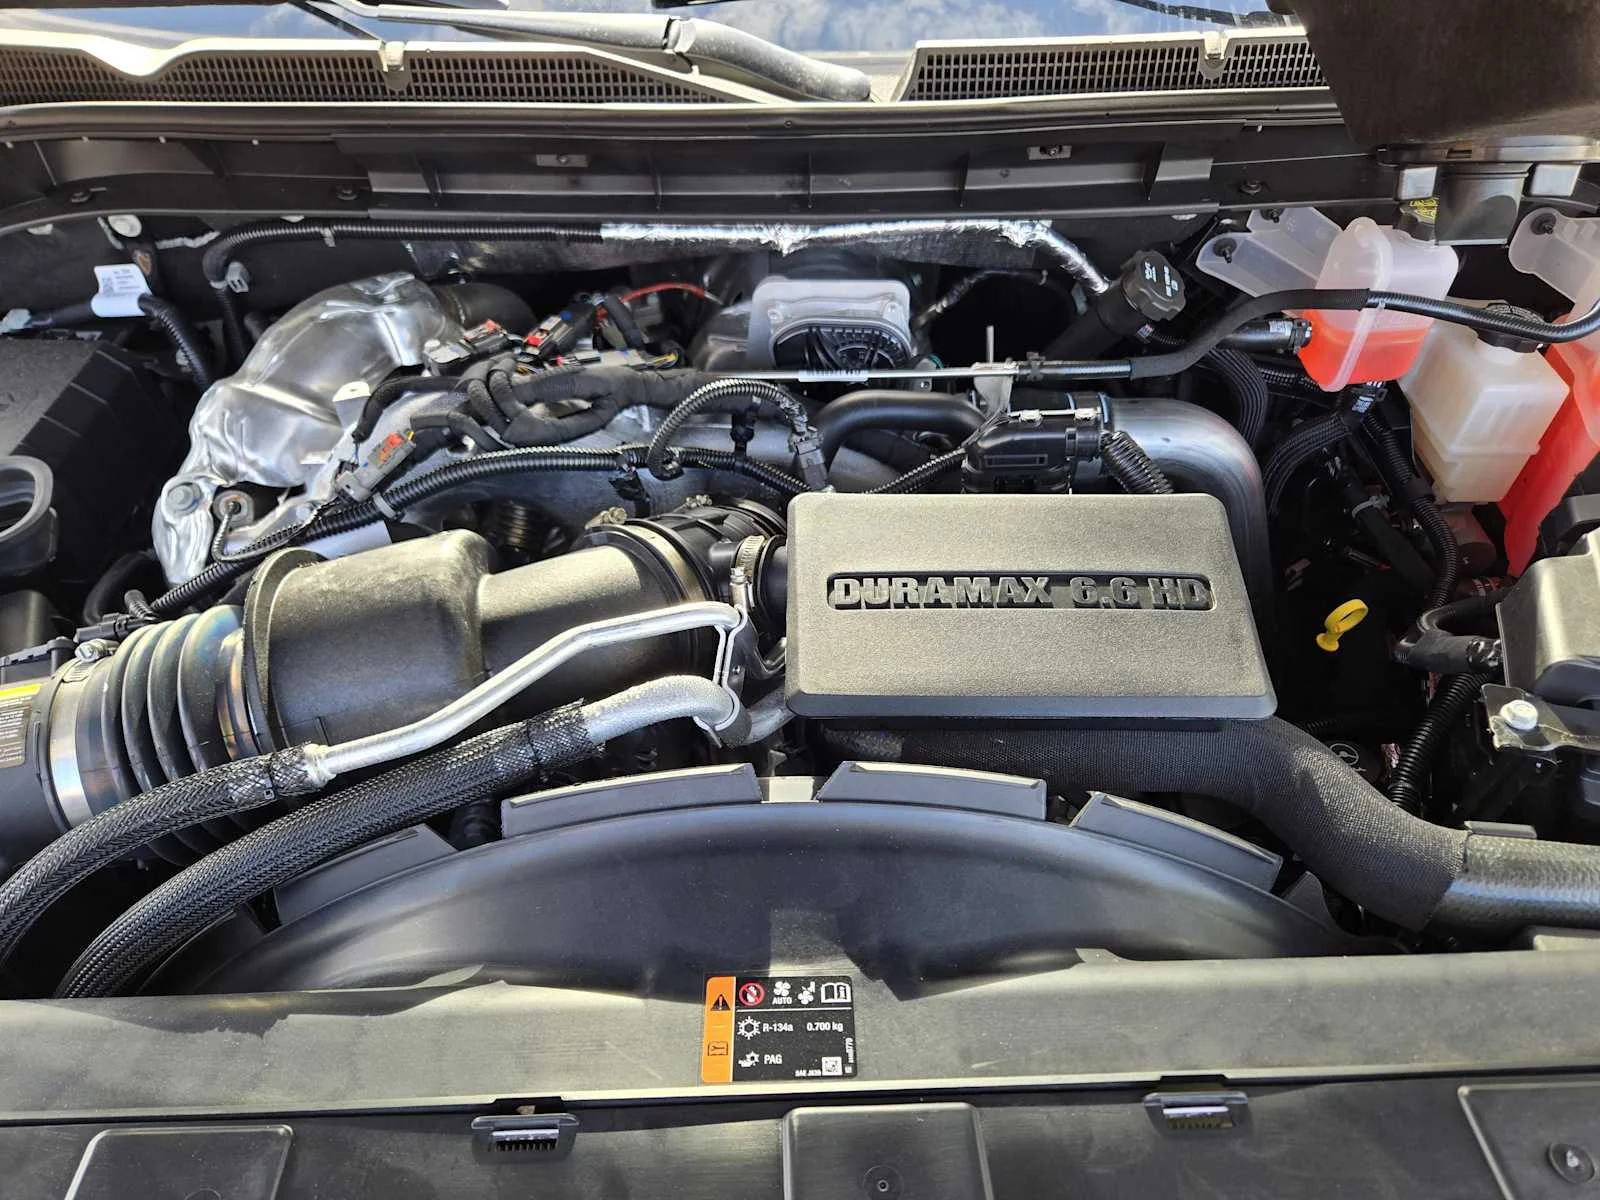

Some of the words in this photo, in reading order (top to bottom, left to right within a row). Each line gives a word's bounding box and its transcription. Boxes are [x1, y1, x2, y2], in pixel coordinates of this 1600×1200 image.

[833, 577, 1052, 607] DURAMAX
[1070, 577, 1140, 607] 6.6
[1148, 577, 1212, 608] HD
[772, 997, 792, 1005] AUTO
[763, 1023, 794, 1032] R-134a
[806, 1021, 831, 1032] 0.700
[832, 1021, 844, 1032] kg
[764, 1054, 783, 1065] PAG
